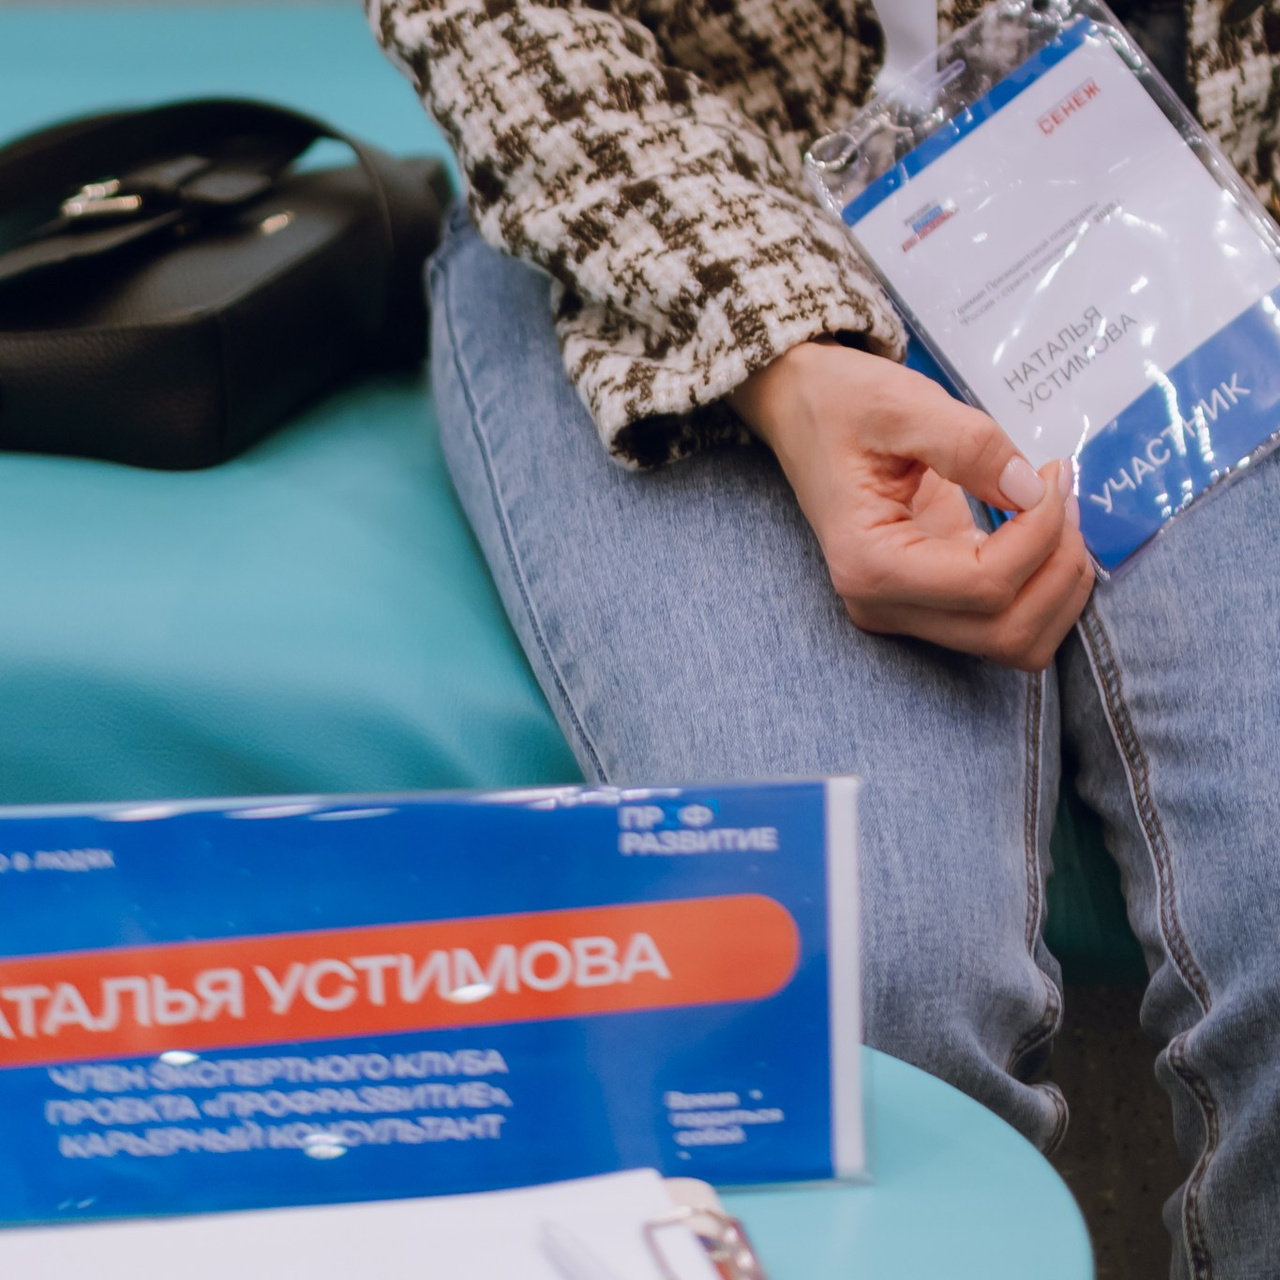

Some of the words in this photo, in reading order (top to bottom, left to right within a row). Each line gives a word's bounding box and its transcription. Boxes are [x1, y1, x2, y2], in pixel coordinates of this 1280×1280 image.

[1036, 79, 1102, 135] СЕНЕЖ
[1002, 304, 1103, 391] НАТАЛЬЯ
[1017, 312, 1138, 414] УСТИМОВА
[1088, 372, 1251, 514] УЧАСТНИК
[618, 827, 780, 856] РАЗВИТИЕ
[254, 932, 672, 1016] УСТИМОВА
[47, 1063, 149, 1093] ЧЛЕН
[150, 1053, 391, 1091] ЭКСПЕРТНОГО
[391, 1048, 510, 1080] КЛУБА
[44, 1094, 201, 1126] ПРОЕКТА
